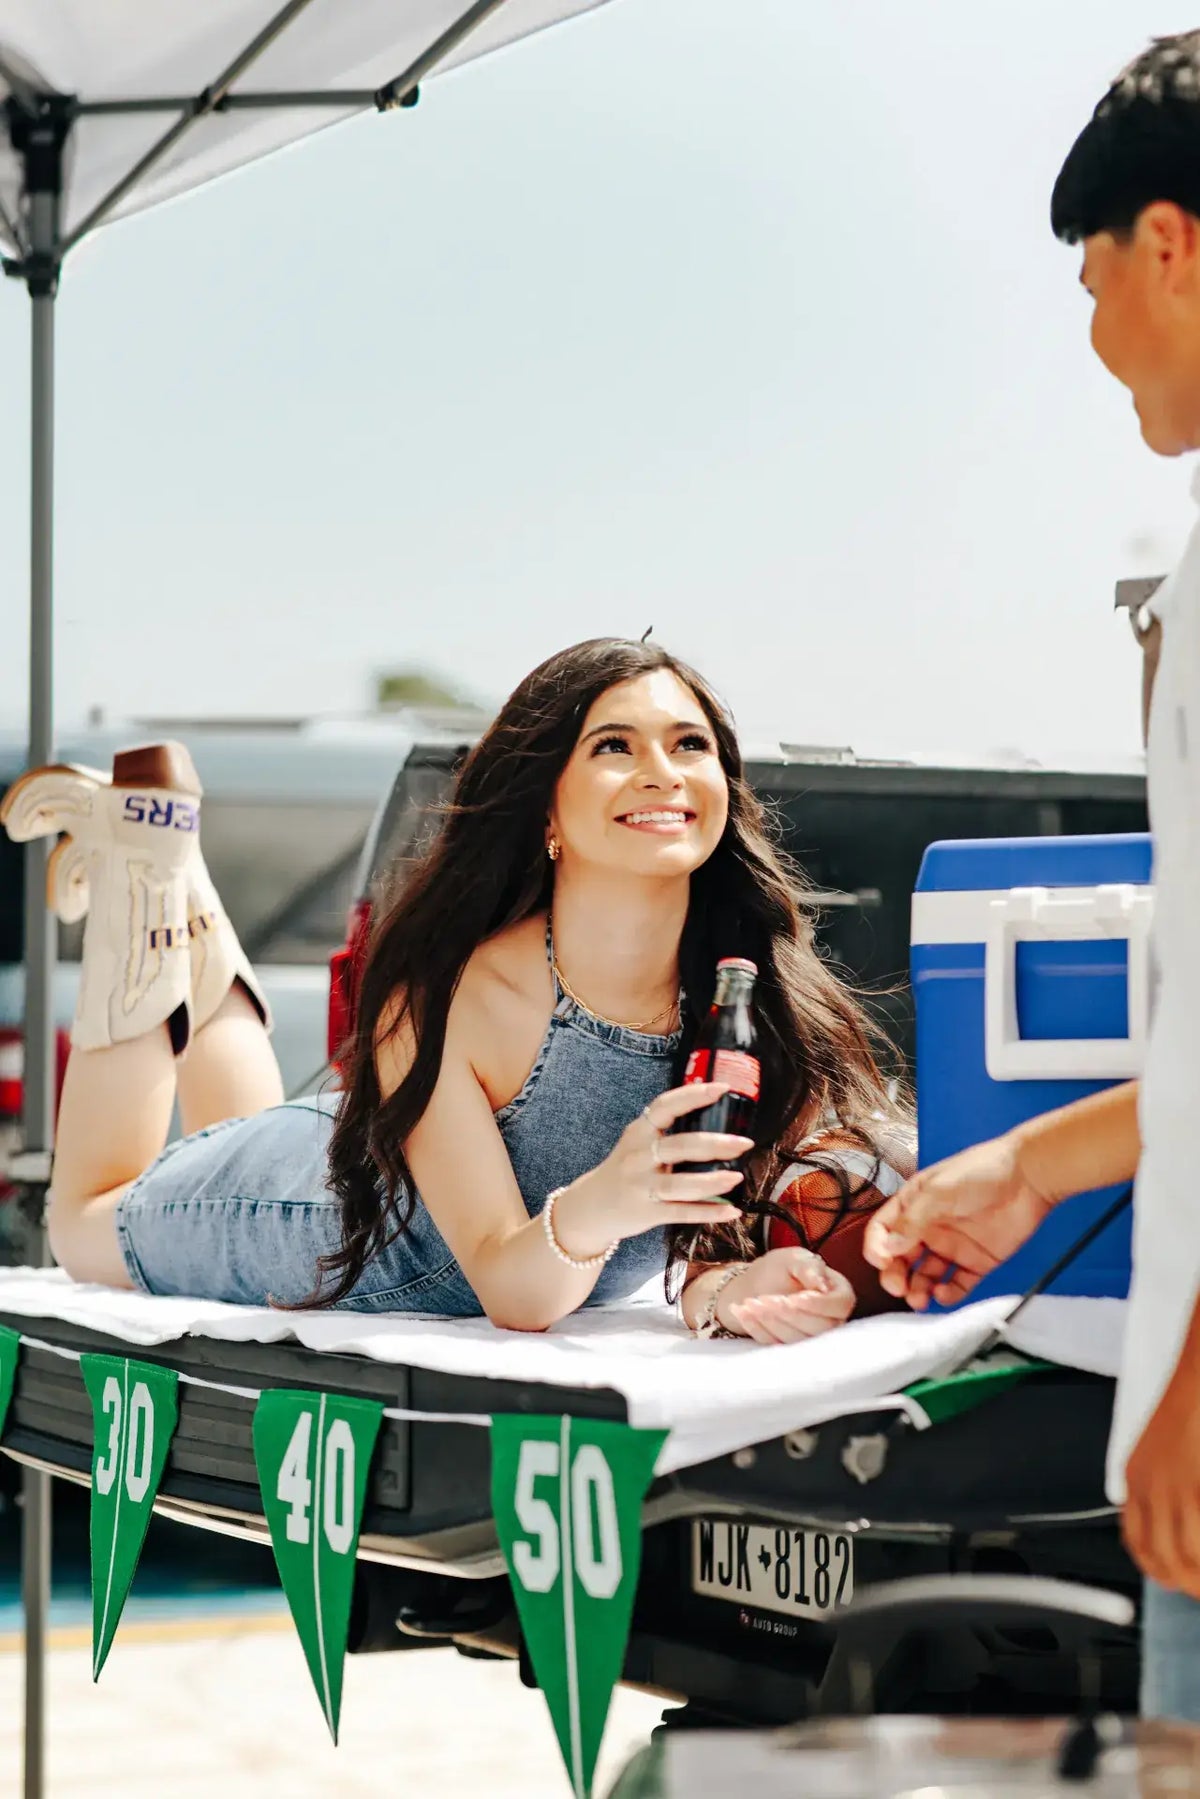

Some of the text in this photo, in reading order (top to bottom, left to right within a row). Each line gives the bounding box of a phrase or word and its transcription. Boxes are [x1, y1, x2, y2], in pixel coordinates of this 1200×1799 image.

[96, 1376, 155, 1503] 30
[277, 1411, 356, 1555] 40
[512, 1440, 624, 1599] 50
[700, 1519, 850, 1611] WJK 8182
